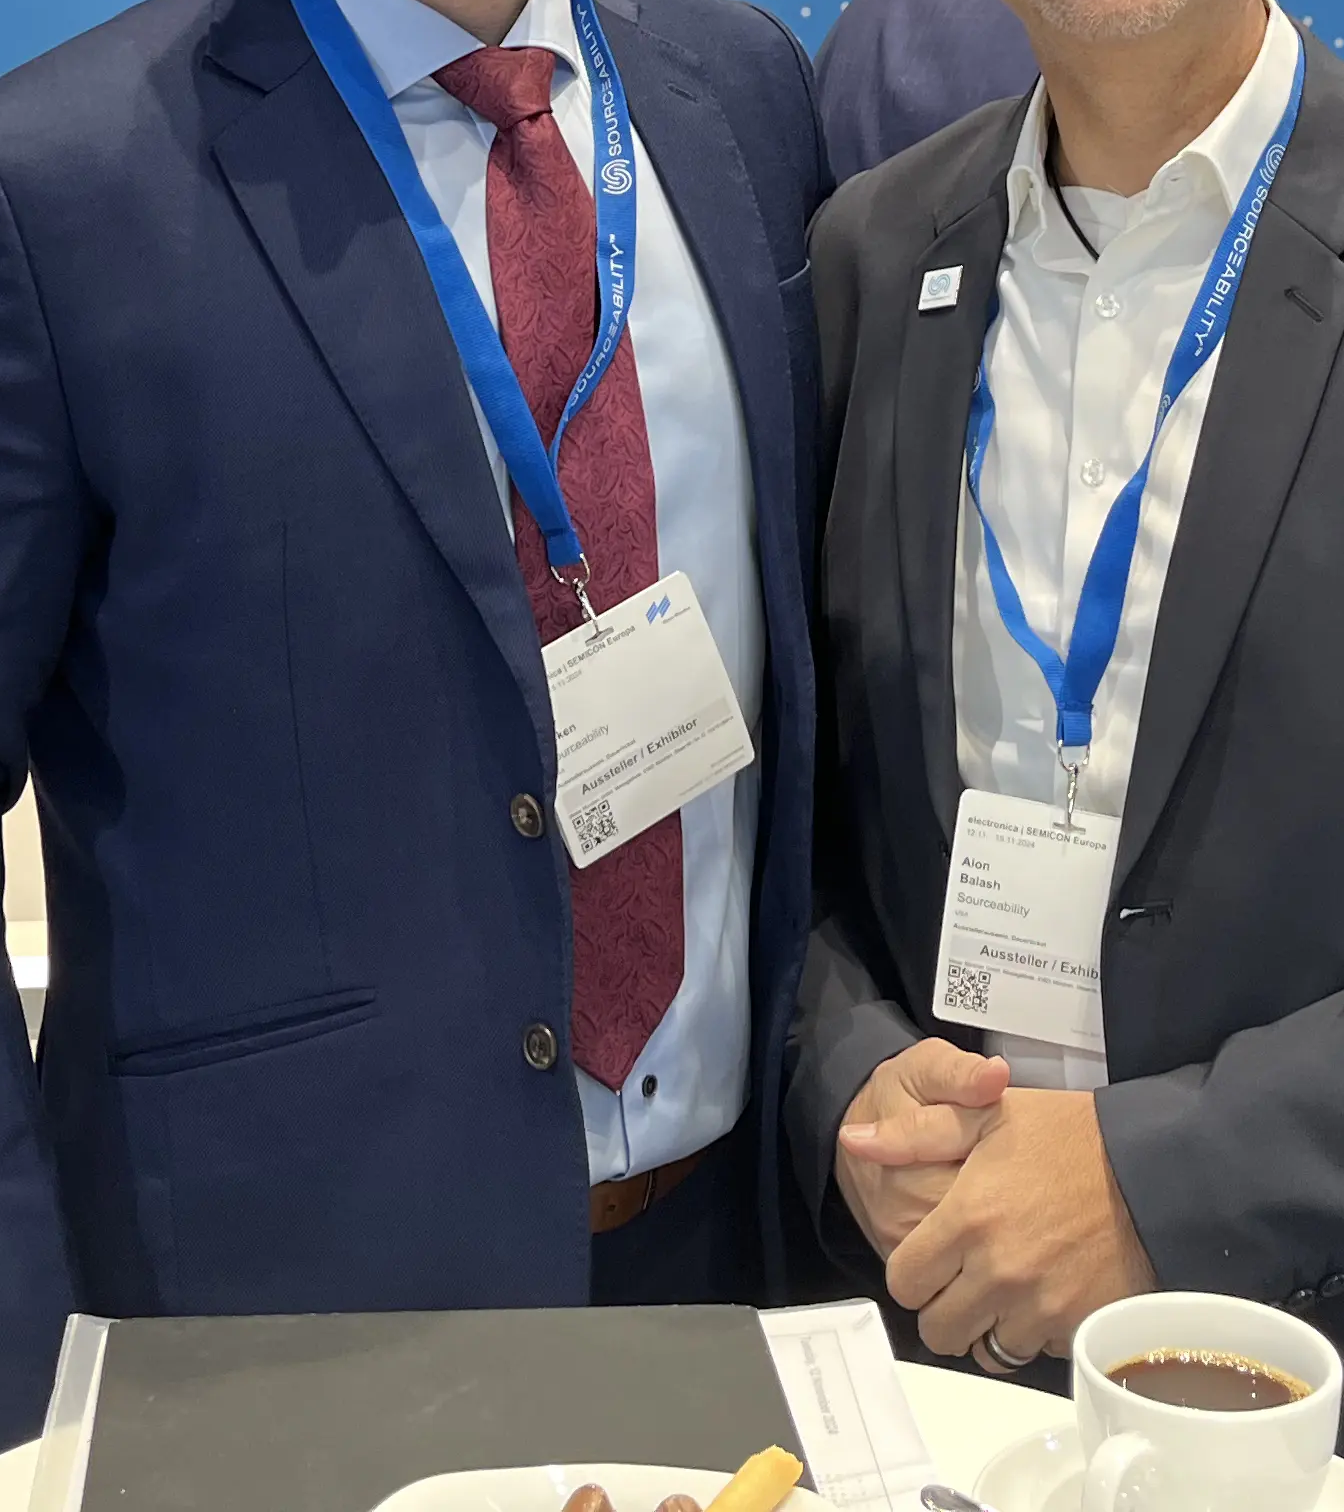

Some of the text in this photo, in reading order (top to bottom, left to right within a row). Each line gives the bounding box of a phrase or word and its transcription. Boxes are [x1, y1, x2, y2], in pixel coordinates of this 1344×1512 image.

[566, 640, 606, 668] SEMICON
[606, 624, 636, 647] Europa
[581, 753, 638, 796] Aussteller
[646, 717, 698, 755] Exhibitor
[967, 815, 1019, 833] electronica
[1026, 826, 1071, 843] SEMICON
[1073, 835, 1107, 851] Europa
[961, 856, 991, 871] Alon
[959, 872, 1002, 891] Balash
[957, 891, 1031, 918] Sourceability
[979, 944, 1049, 970] Aussteller
